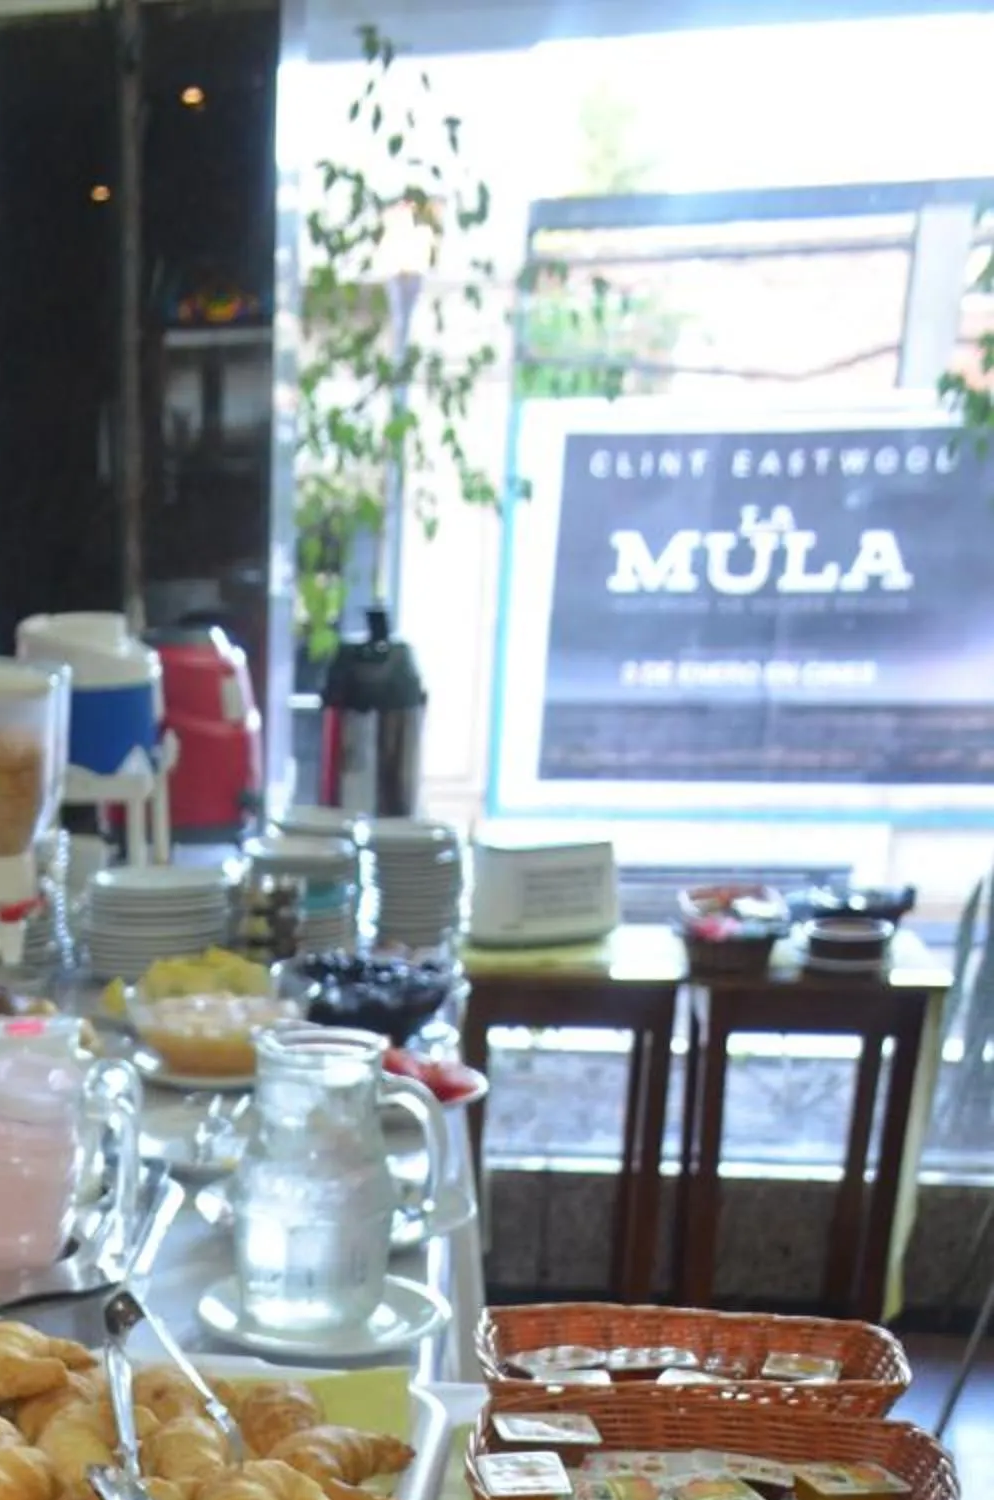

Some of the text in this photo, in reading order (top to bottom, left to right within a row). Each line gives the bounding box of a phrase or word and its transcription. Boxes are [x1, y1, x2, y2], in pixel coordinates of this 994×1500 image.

[589, 449, 708, 478] CLINT
[740, 504, 795, 535] LA
[608, 530, 913, 594] MULA
